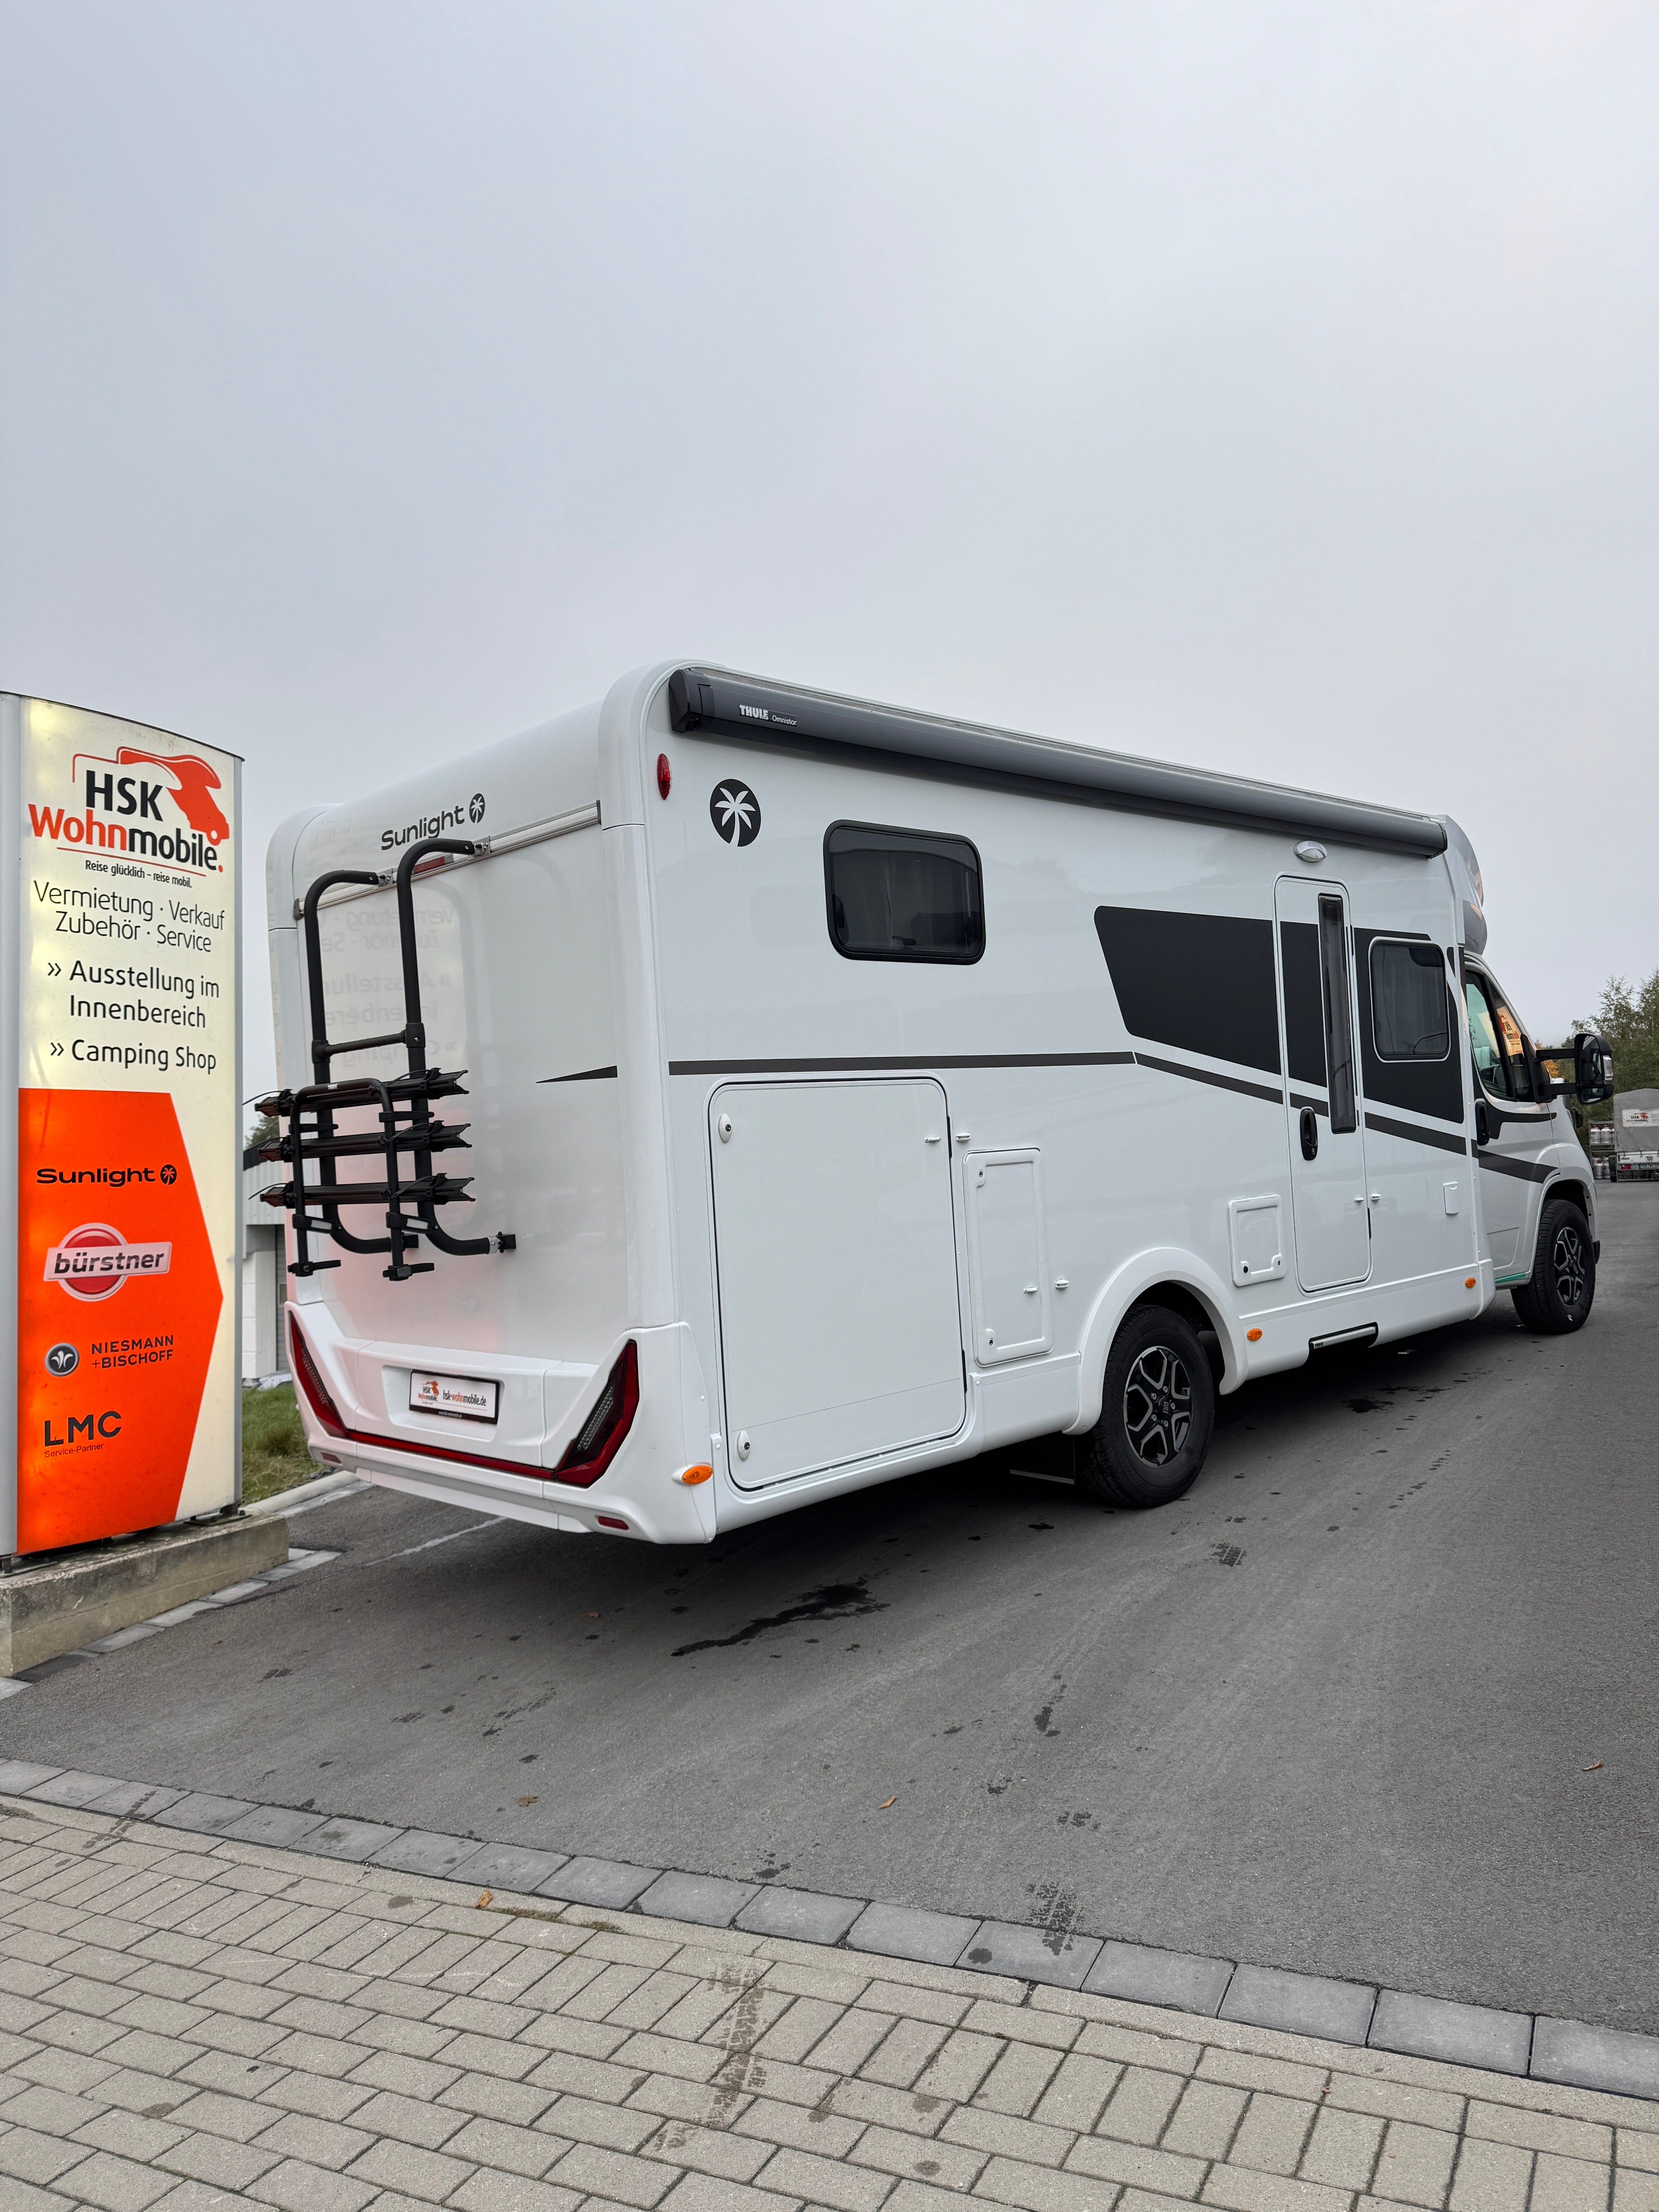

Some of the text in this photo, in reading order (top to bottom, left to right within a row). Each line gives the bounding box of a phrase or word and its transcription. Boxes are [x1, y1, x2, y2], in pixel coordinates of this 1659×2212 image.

[739, 704, 797, 726] THULE Omnistor
[86, 769, 163, 821] HSK
[28, 804, 223, 872] Wohnmobile.
[381, 805, 465, 850] Sunlight
[85, 860, 108, 872] Reise
[111, 864, 145, 879] glücklich
[153, 872, 170, 883] reise
[172, 874, 192, 888] mobil.
[33, 880, 153, 922] Vermietung
[169, 900, 225, 930] Verkauf
[55, 911, 141, 941] Zubehör
[157, 924, 211, 952] Service
[69, 960, 220, 999] Ausstellung im
[70, 994, 206, 1028] Innenbereich
[72, 1039, 217, 1075] Camping Shop
[36, 1168, 156, 1187] Sunlight
[54, 1252, 164, 1274] bürstner
[91, 1334, 174, 1355] NIESMANN
[92, 1349, 173, 1369] +BISCHOFF
[423, 1386, 431, 1394] HSK
[443, 1389, 487, 1406] hsk-wohnmobile.de
[44, 1411, 122, 1447] LMC
[44, 1443, 104, 1458] Service-Partner
